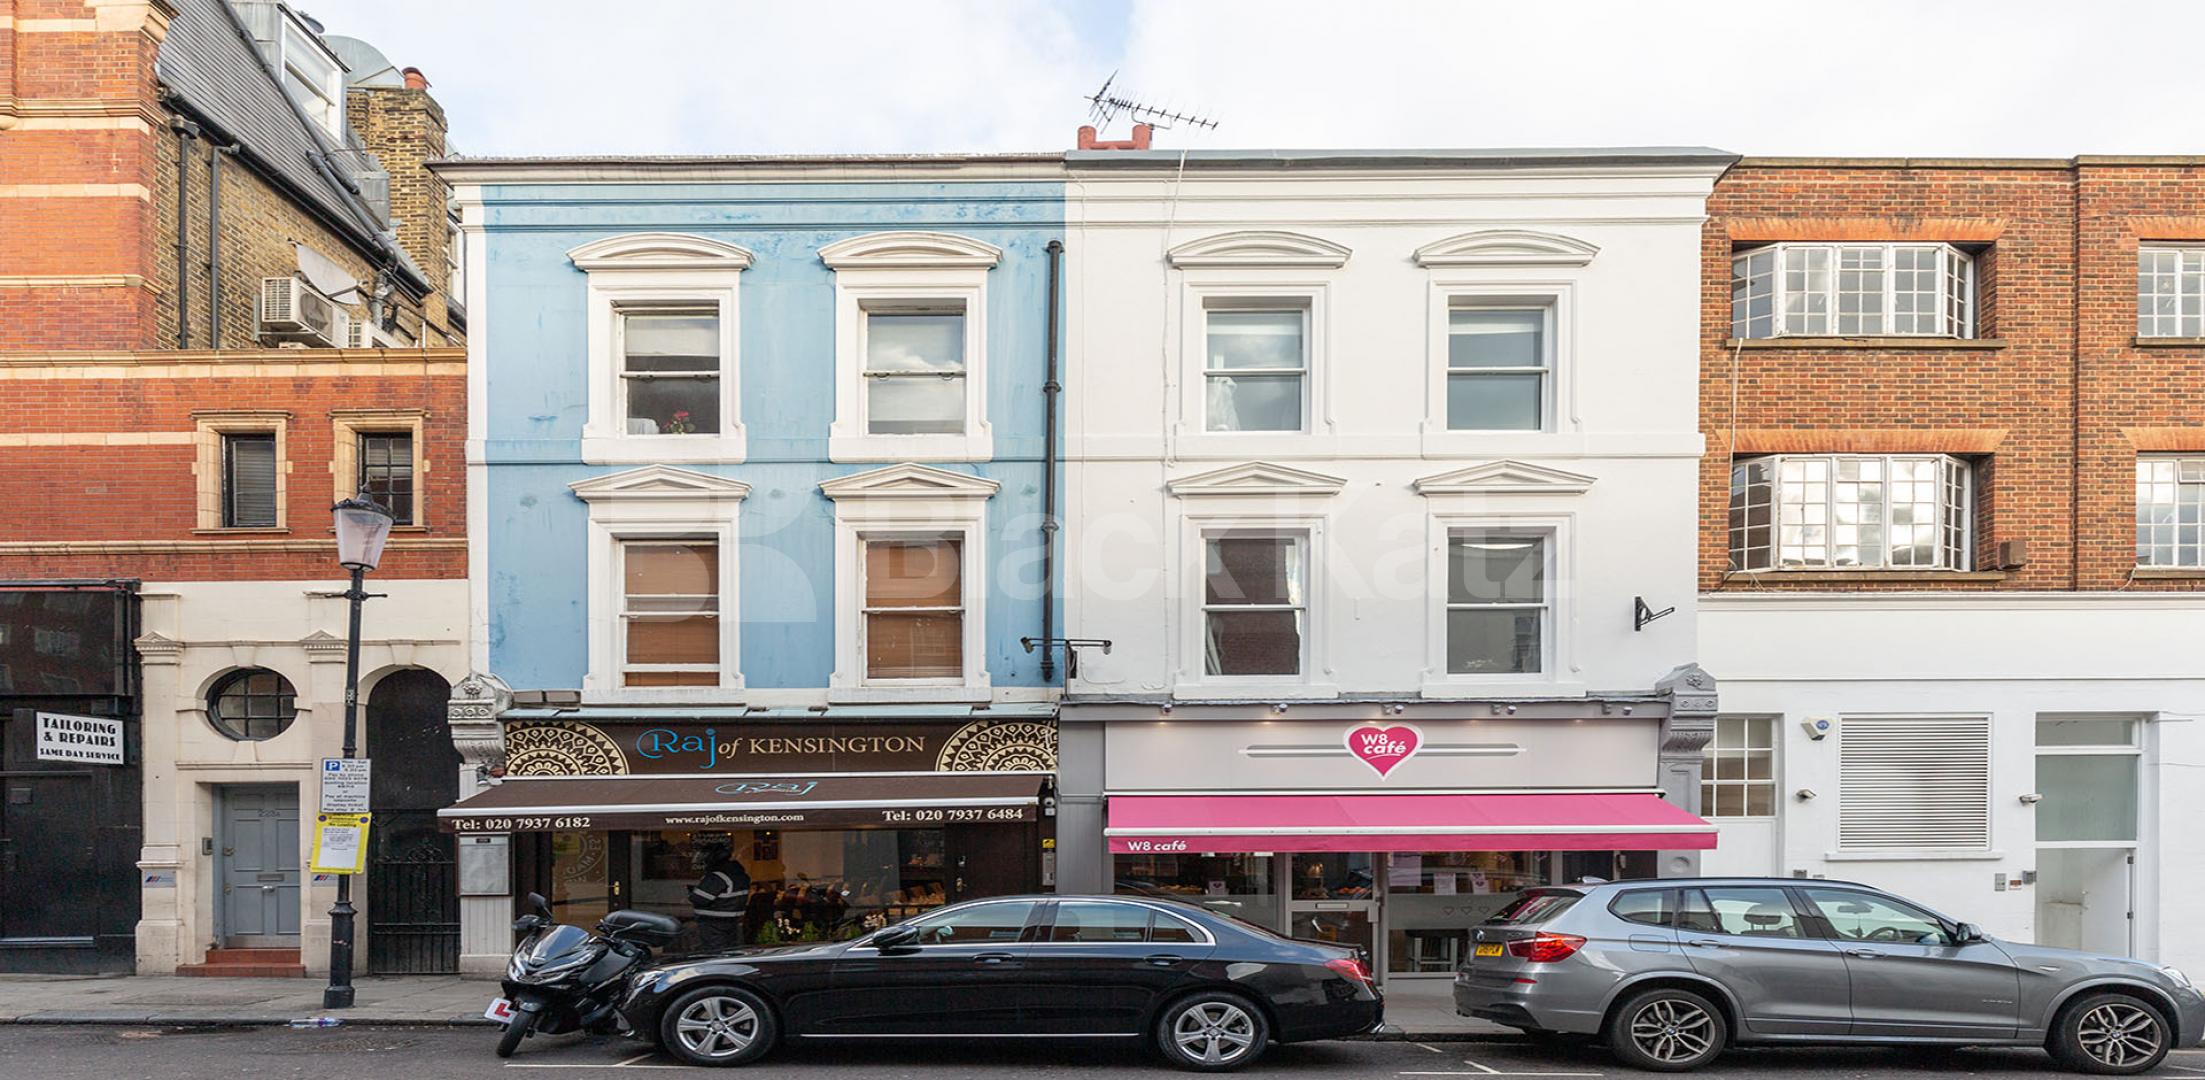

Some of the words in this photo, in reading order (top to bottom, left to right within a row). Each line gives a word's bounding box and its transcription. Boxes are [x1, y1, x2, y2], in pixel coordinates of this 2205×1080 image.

[42, 717, 116, 735] TAILORING
[43, 731, 53, 742] &
[59, 732, 116, 747] REPAIRS
[1361, 733, 1389, 745] W8
[40, 748, 64, 756] SAME
[65, 749, 84, 758] DAY
[86, 751, 120, 760] SERVICE
[635, 728, 717, 770] Raj
[718, 738, 744, 759] of
[749, 736, 926, 755] KENSINGTON
[1363, 740, 1407, 755] café
[665, 814, 805, 826] www.rajofkensington.com
[881, 810, 911, 821] Tel:
[915, 810, 943, 821] 020
[947, 809, 983, 820] 7937
[987, 808, 1023, 820] 6484
[451, 819, 481, 830] Tel:
[485, 819, 512, 830] 020
[516, 818, 551, 829] 7937
[555, 817, 591, 829] 6182
[1127, 841, 1152, 851] W8
[1153, 840, 1187, 851] café
